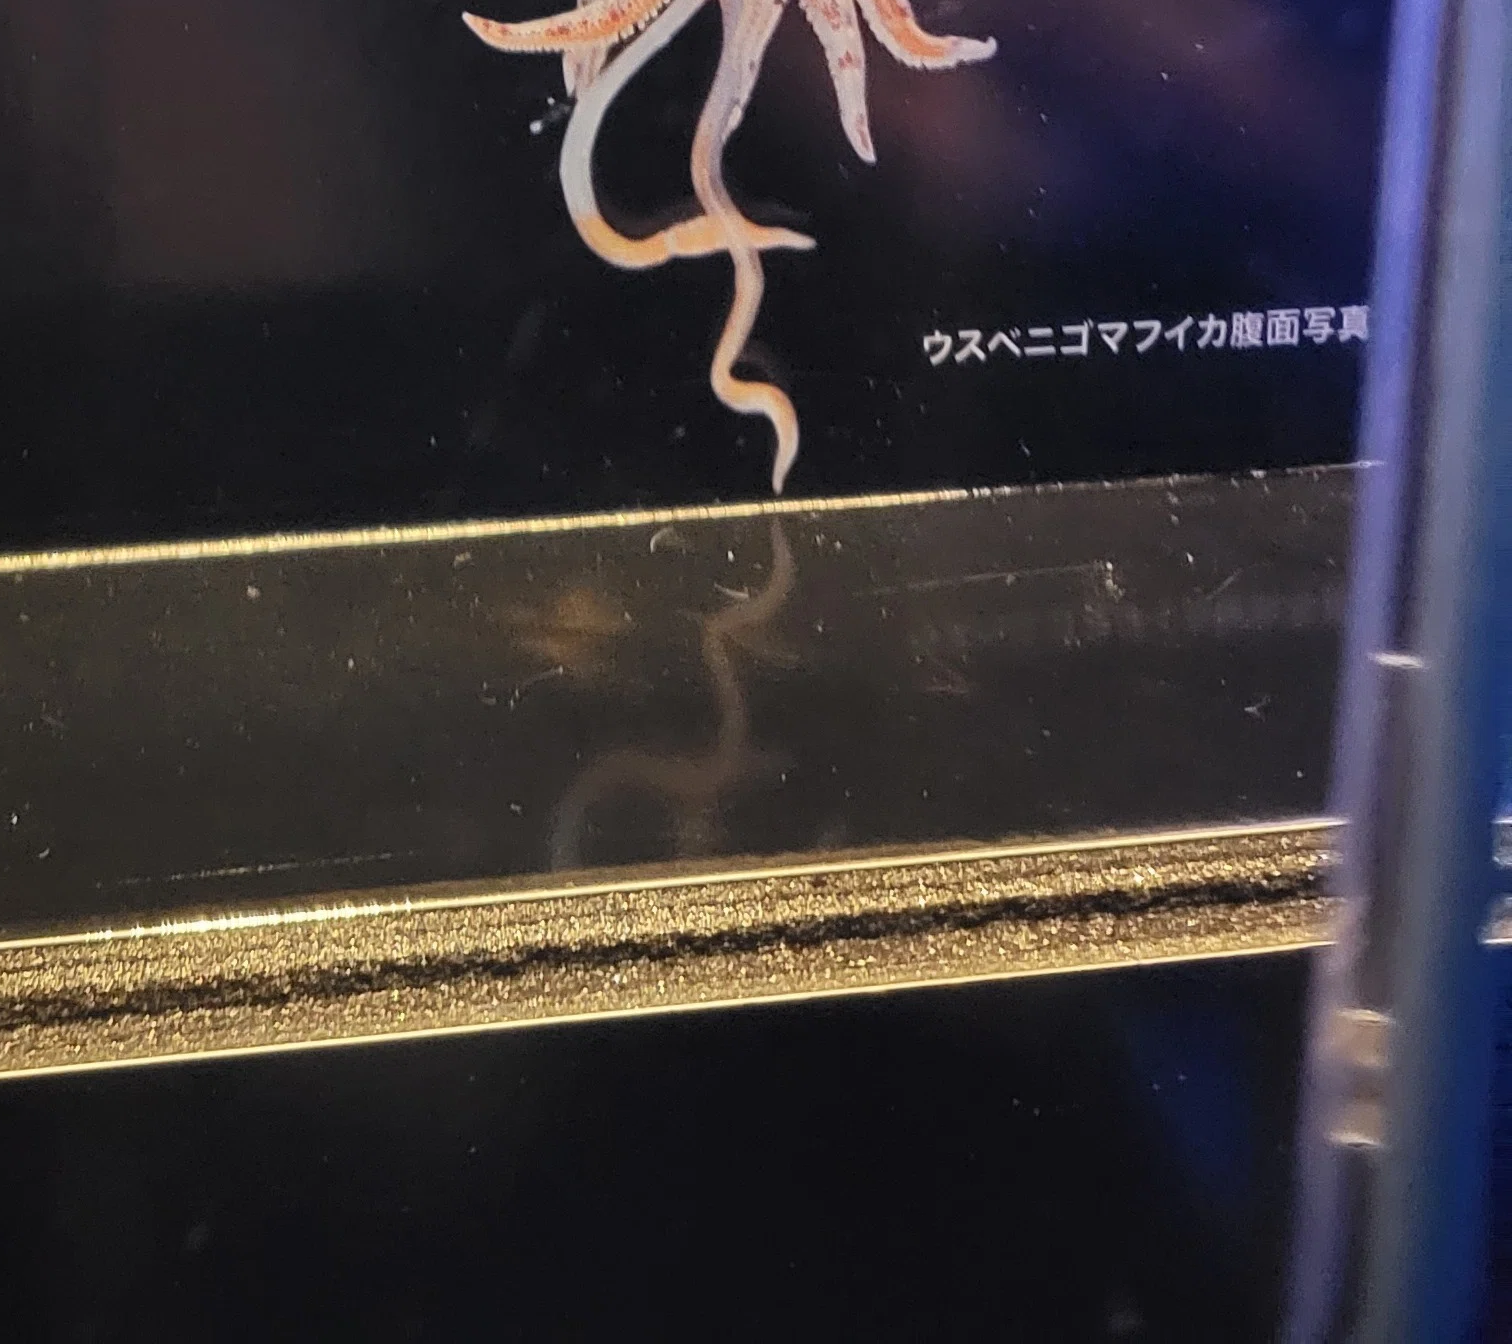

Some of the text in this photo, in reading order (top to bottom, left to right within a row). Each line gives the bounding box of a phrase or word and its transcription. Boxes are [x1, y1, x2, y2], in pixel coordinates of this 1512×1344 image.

[923, 304, 1370, 367] ウスベニゴマフイカ腹面写真
